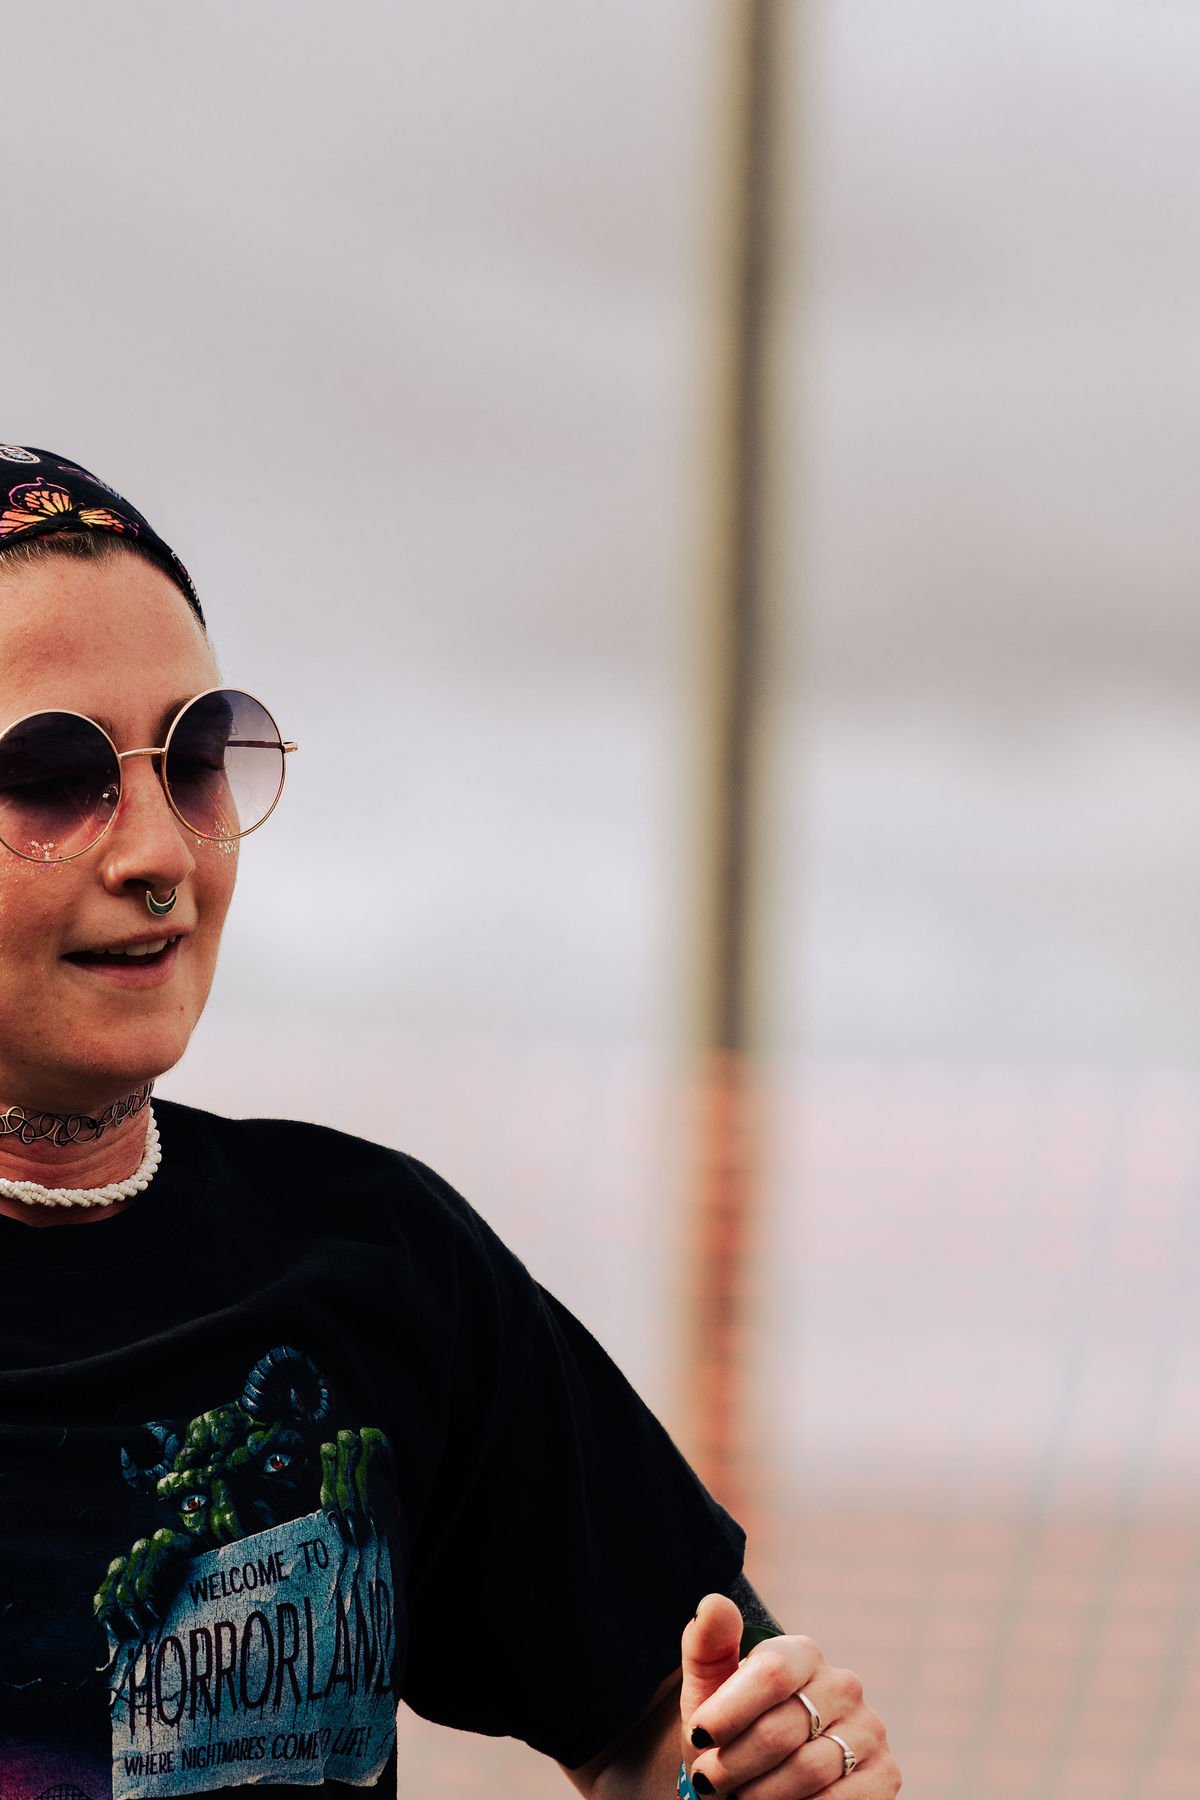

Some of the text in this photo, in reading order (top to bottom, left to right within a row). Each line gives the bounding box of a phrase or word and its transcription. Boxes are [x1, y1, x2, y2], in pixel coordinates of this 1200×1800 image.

[189, 1538, 330, 1605] WELCOME TO
[127, 1578, 394, 1730] HORRORLAND
[124, 1750, 175, 1777] WHERE
[182, 1735, 266, 1770] NIGHTMARES
[272, 1731, 319, 1761] COME
